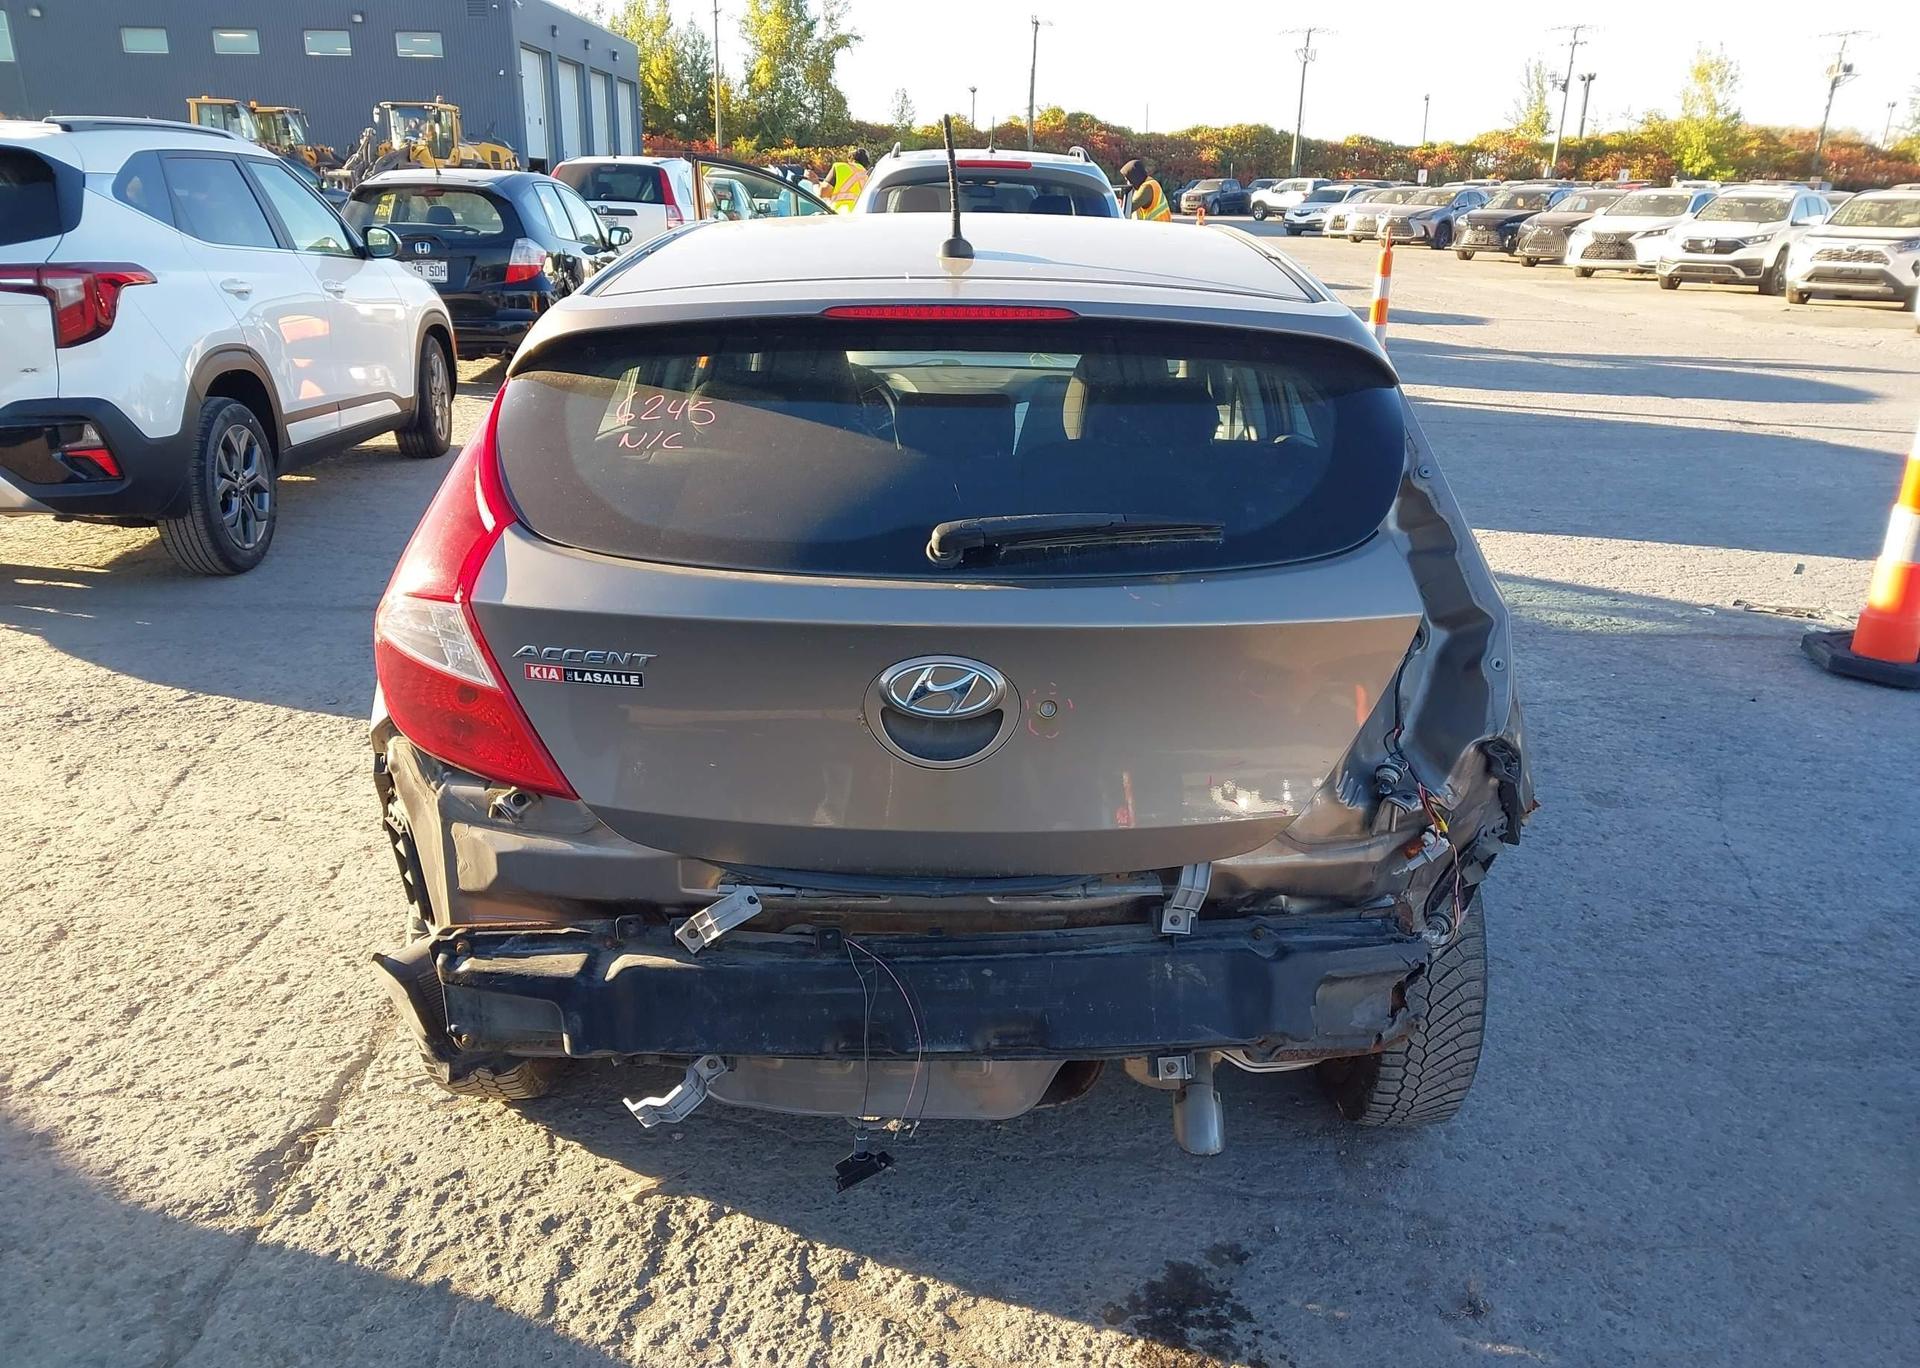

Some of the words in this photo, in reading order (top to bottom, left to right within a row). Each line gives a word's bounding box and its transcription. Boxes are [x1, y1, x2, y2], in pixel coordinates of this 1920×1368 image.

[616, 391, 716, 425] 6245
[618, 430, 684, 449] N/C
[512, 645, 658, 667] ACCENT
[530, 666, 560, 681] KIA
[574, 671, 640, 686] LASALLE
